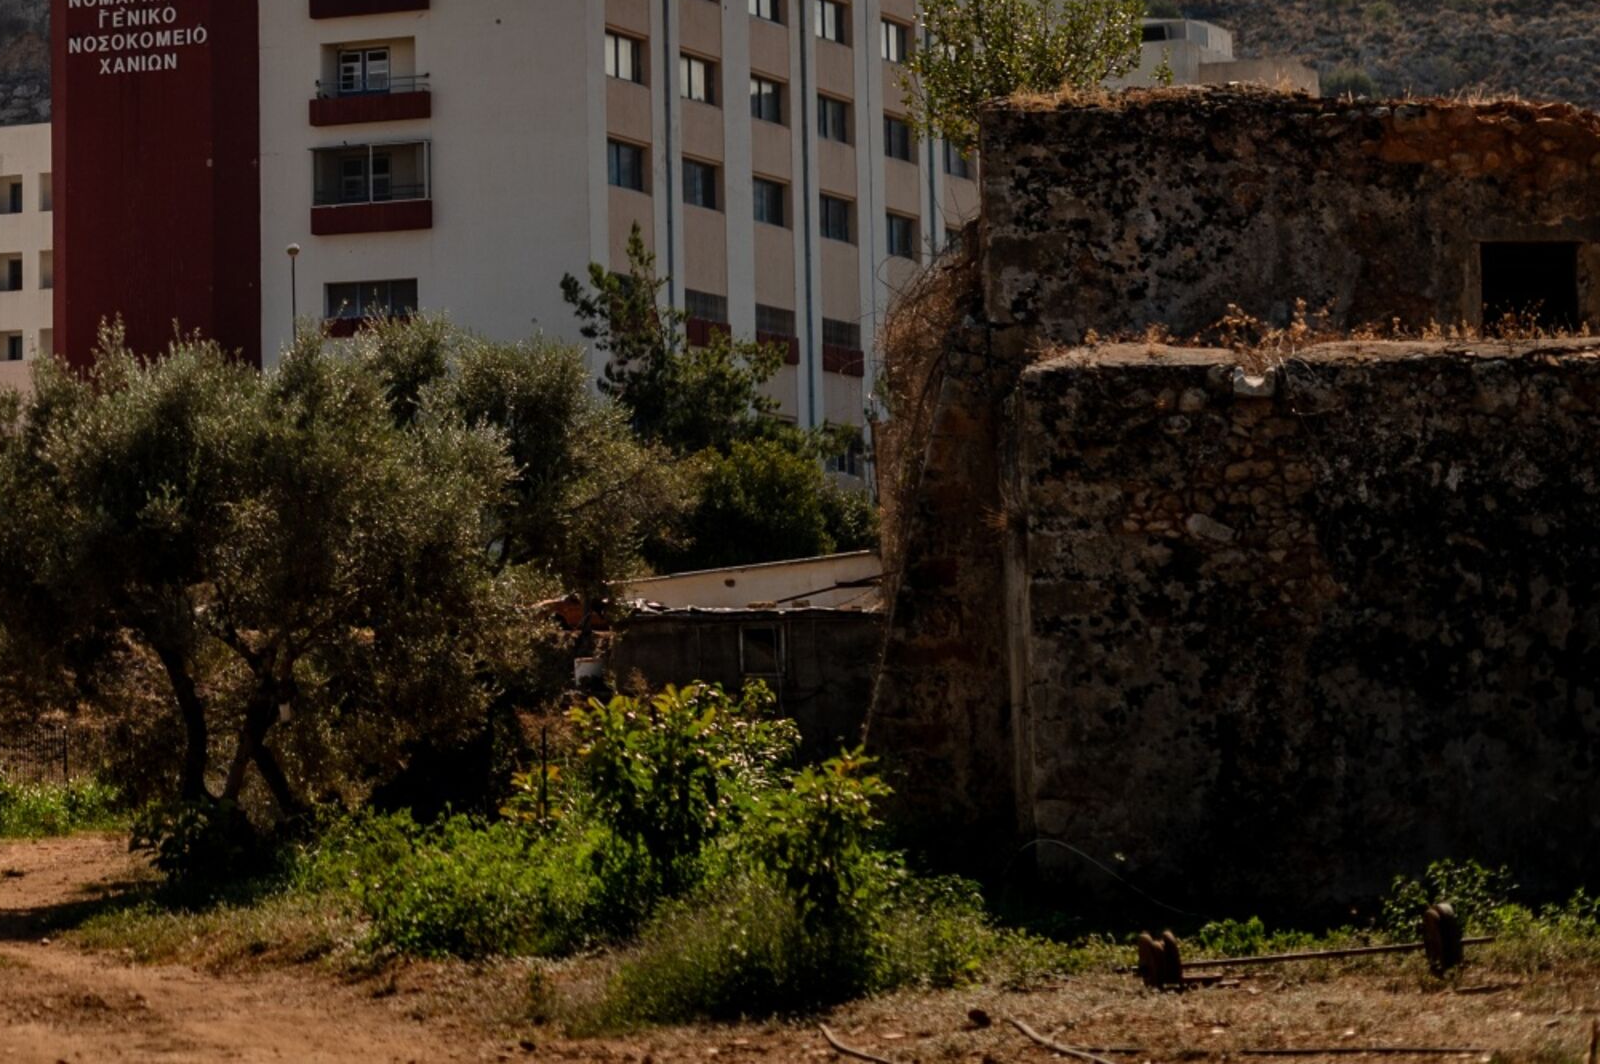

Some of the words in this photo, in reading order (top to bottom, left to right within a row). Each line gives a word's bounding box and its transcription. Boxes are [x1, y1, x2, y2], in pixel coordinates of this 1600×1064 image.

[98, 7, 177, 29] ΓΕΝΙΚΟ
[68, 26, 208, 54] ΝΟΣΟΚΟΜΕΙΟ
[100, 53, 178, 75] ΧΑΝΙΩΝ
